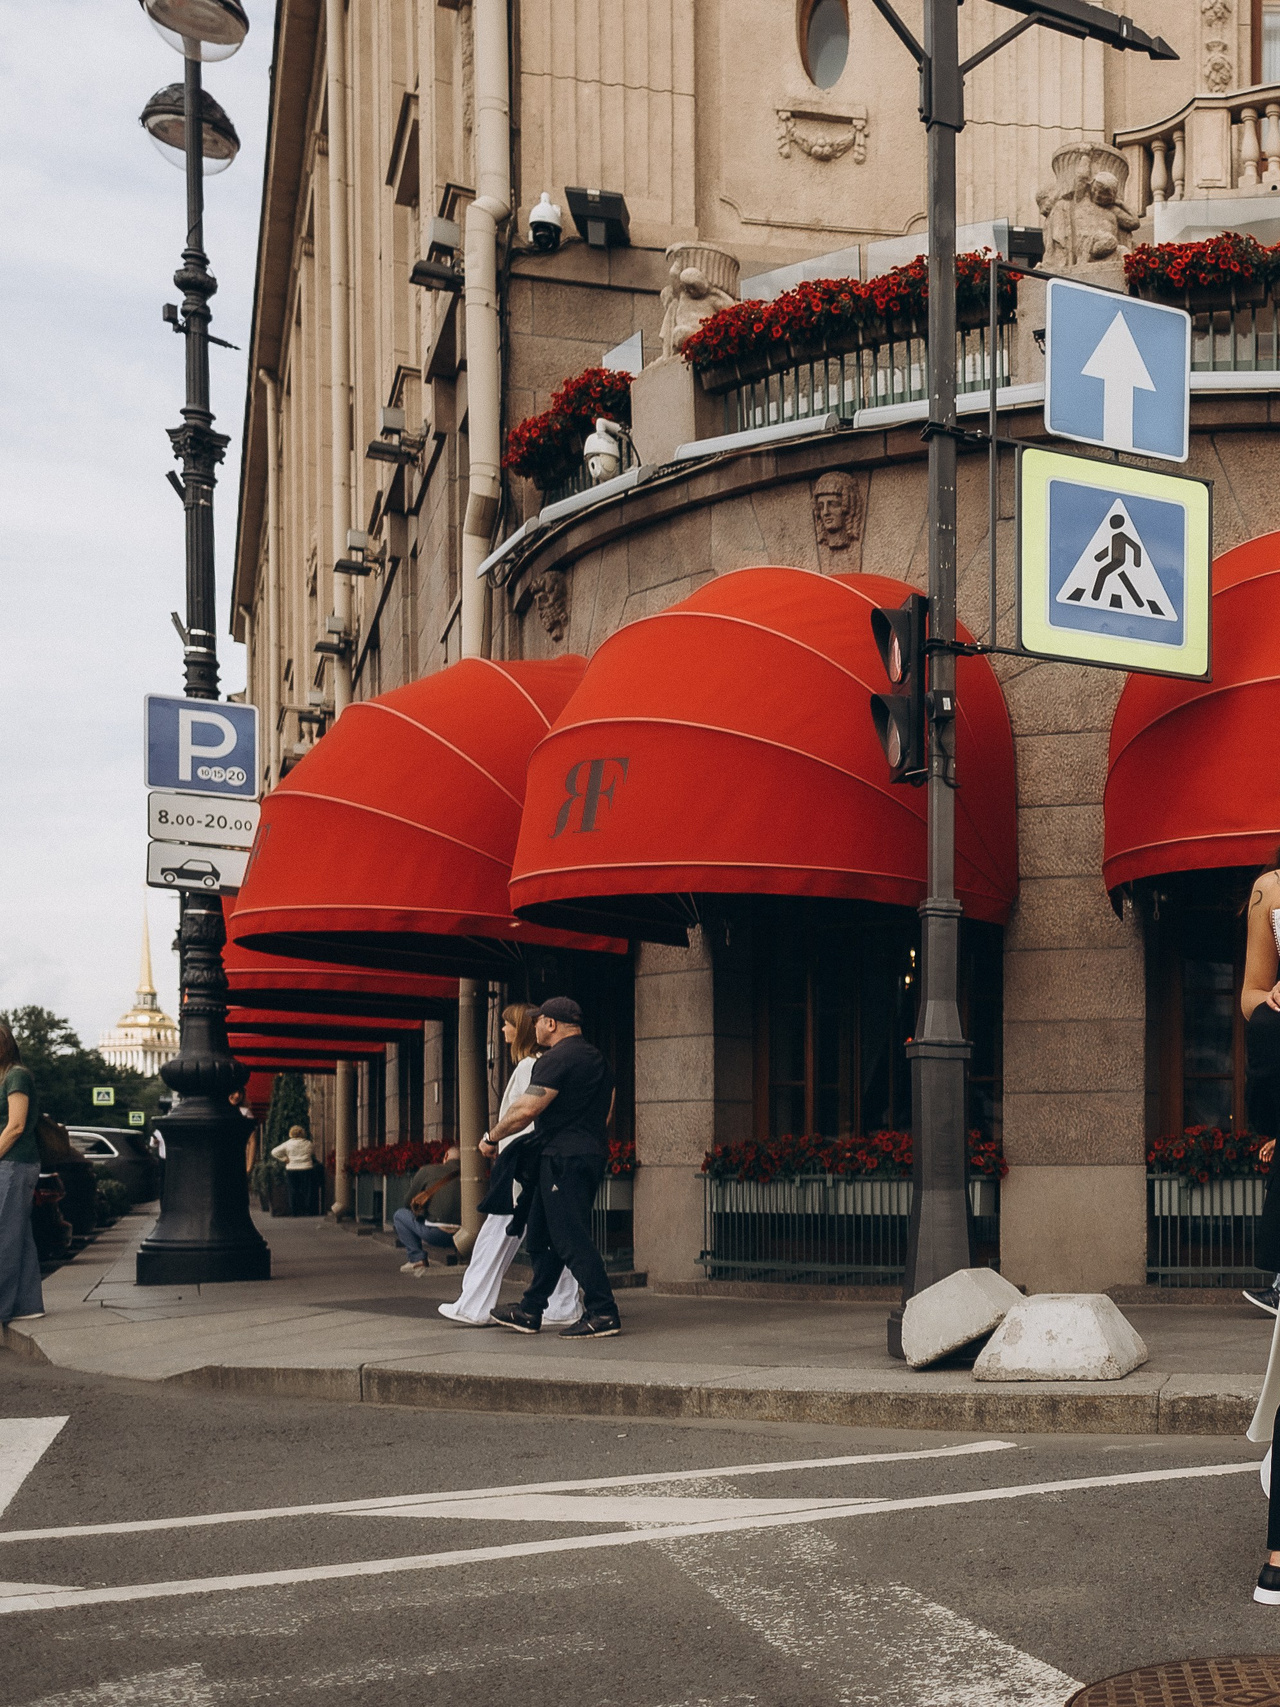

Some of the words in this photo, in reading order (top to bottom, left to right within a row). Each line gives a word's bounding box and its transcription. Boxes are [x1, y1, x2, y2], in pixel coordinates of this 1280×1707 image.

[179, 708, 238, 781] P
[200, 768, 210, 776] 10
[213, 769, 224, 778] 15
[228, 770, 245, 781] 20
[158, 809, 253, 831] 8.00-20.00
